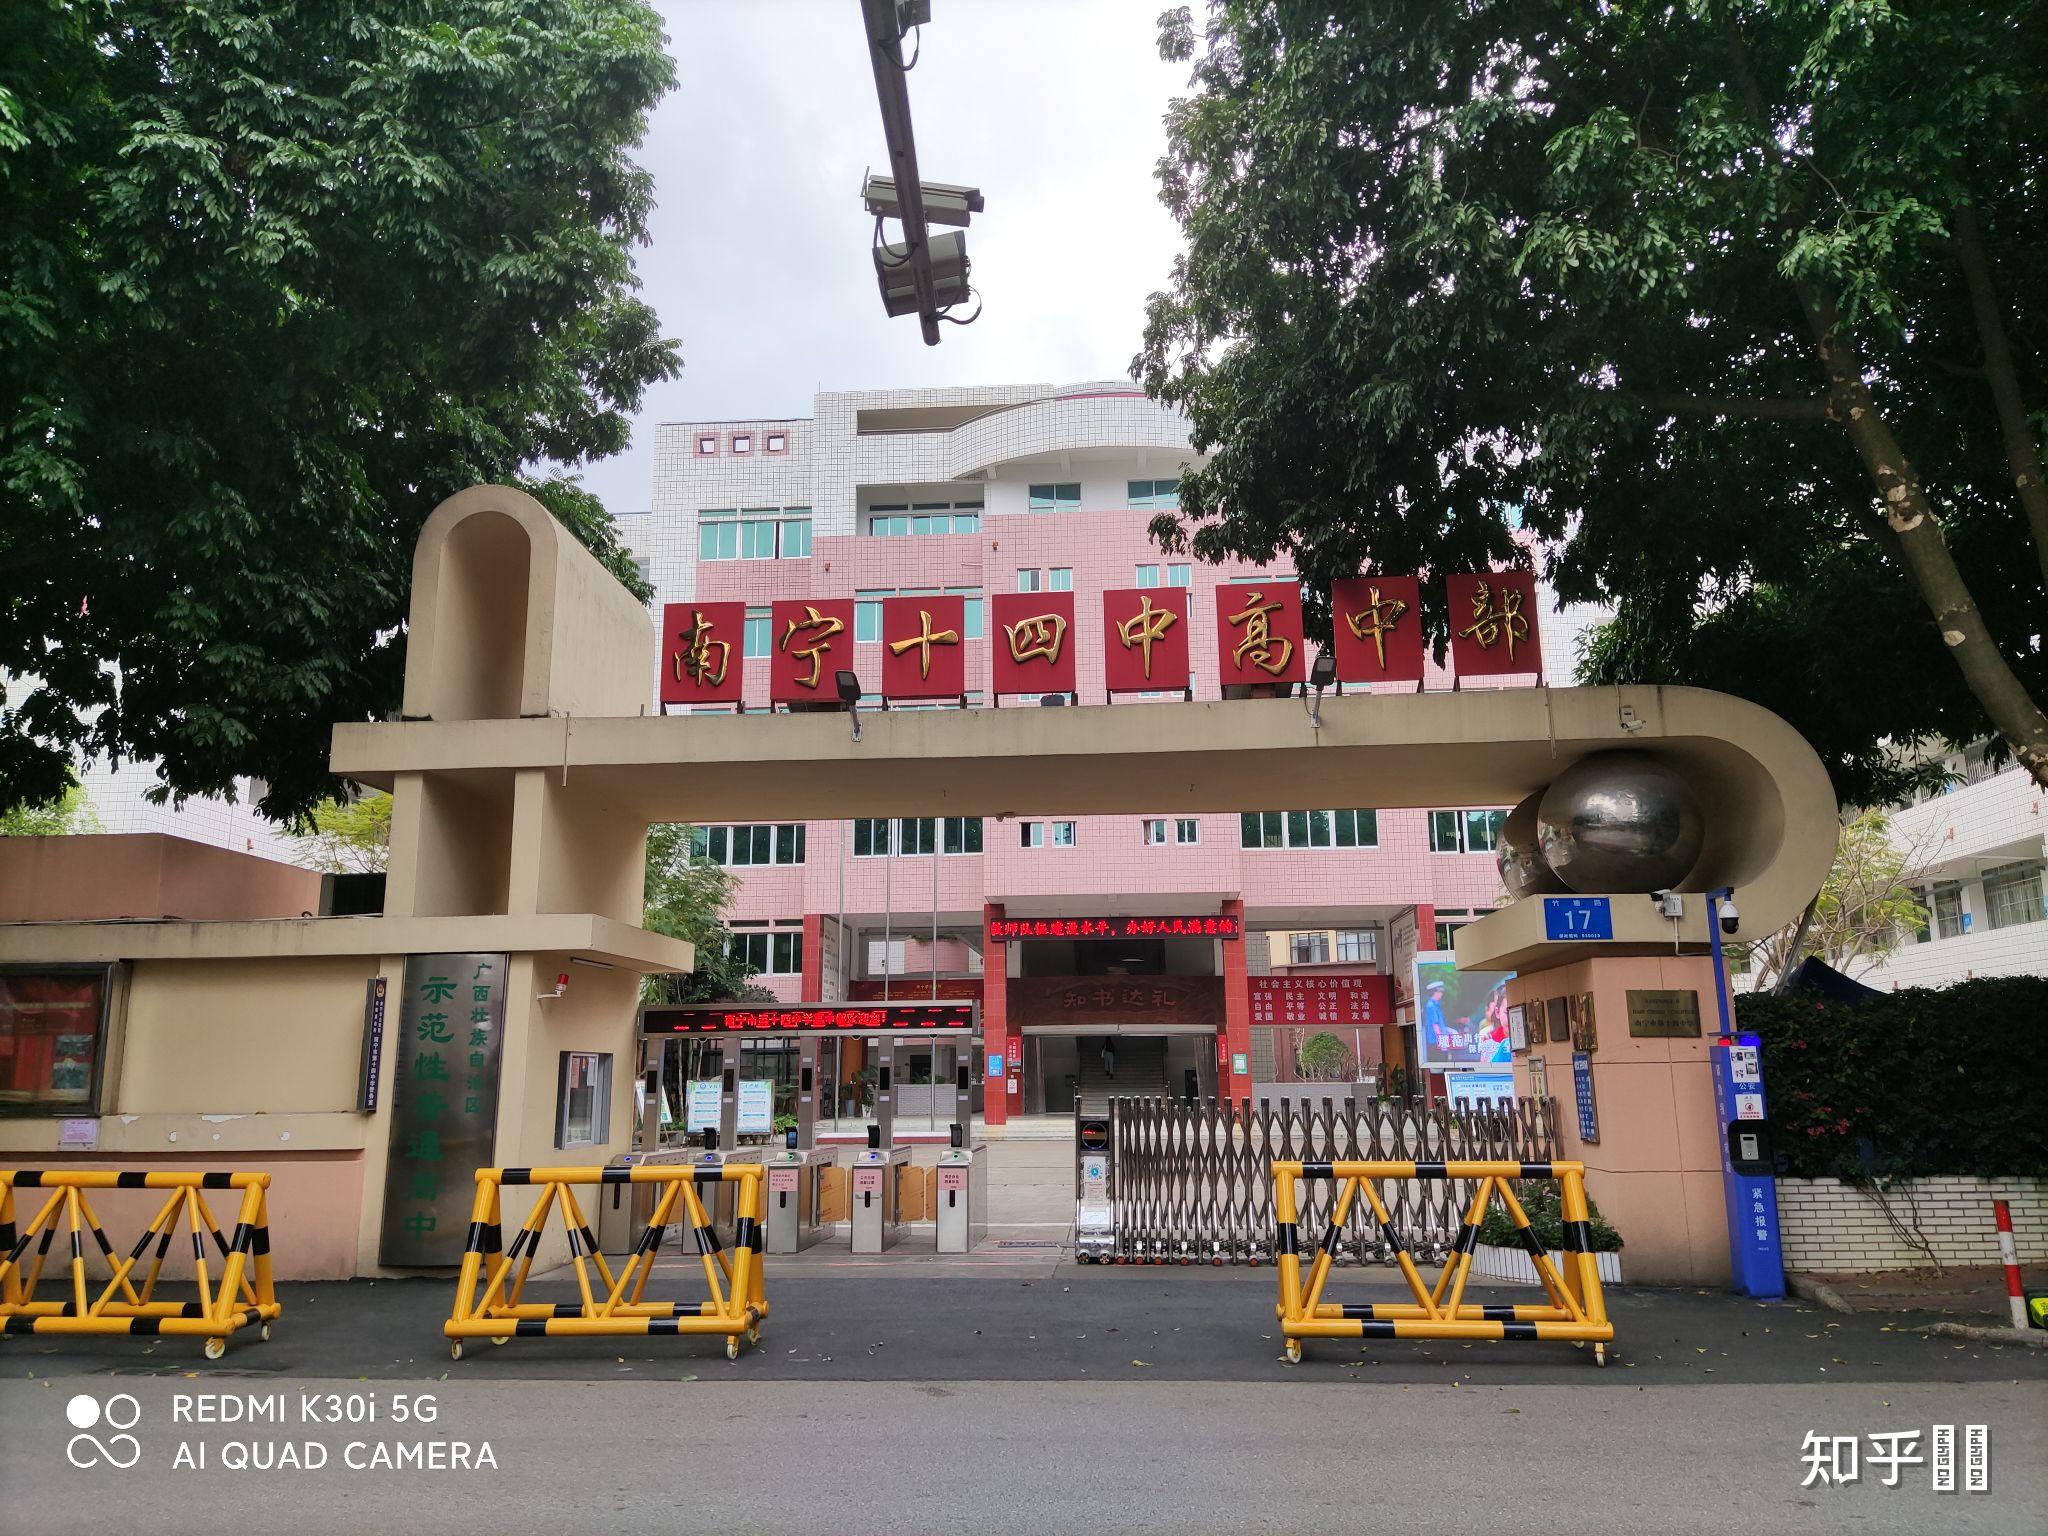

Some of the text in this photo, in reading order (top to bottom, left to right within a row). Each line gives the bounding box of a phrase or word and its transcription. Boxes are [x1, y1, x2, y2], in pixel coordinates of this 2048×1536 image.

[674, 580, 1529, 687] 南宁十四中高中部
[991, 919, 1238, 938] 教师队伍建设水平，办好人民满意的
[1564, 910, 1591, 930] 17
[1259, 979, 1362, 989] 社会主义核心价值观
[1063, 989, 1176, 1007] 知书达礼
[1253, 992, 1369, 1001] 富强 民主 文明 和谐
[1254, 1002, 1370, 1011] 自由 平等 公正 法治
[1255, 1012, 1370, 1021] 爱国 敬业 诚信 友善
[465, 962, 492, 1114] 广西壮族自治区
[1739, 1082, 1755, 1090] 公安
[403, 976, 458, 1242] 示范性普通高中
[1752, 1187, 1767, 1241] 紧急报警
